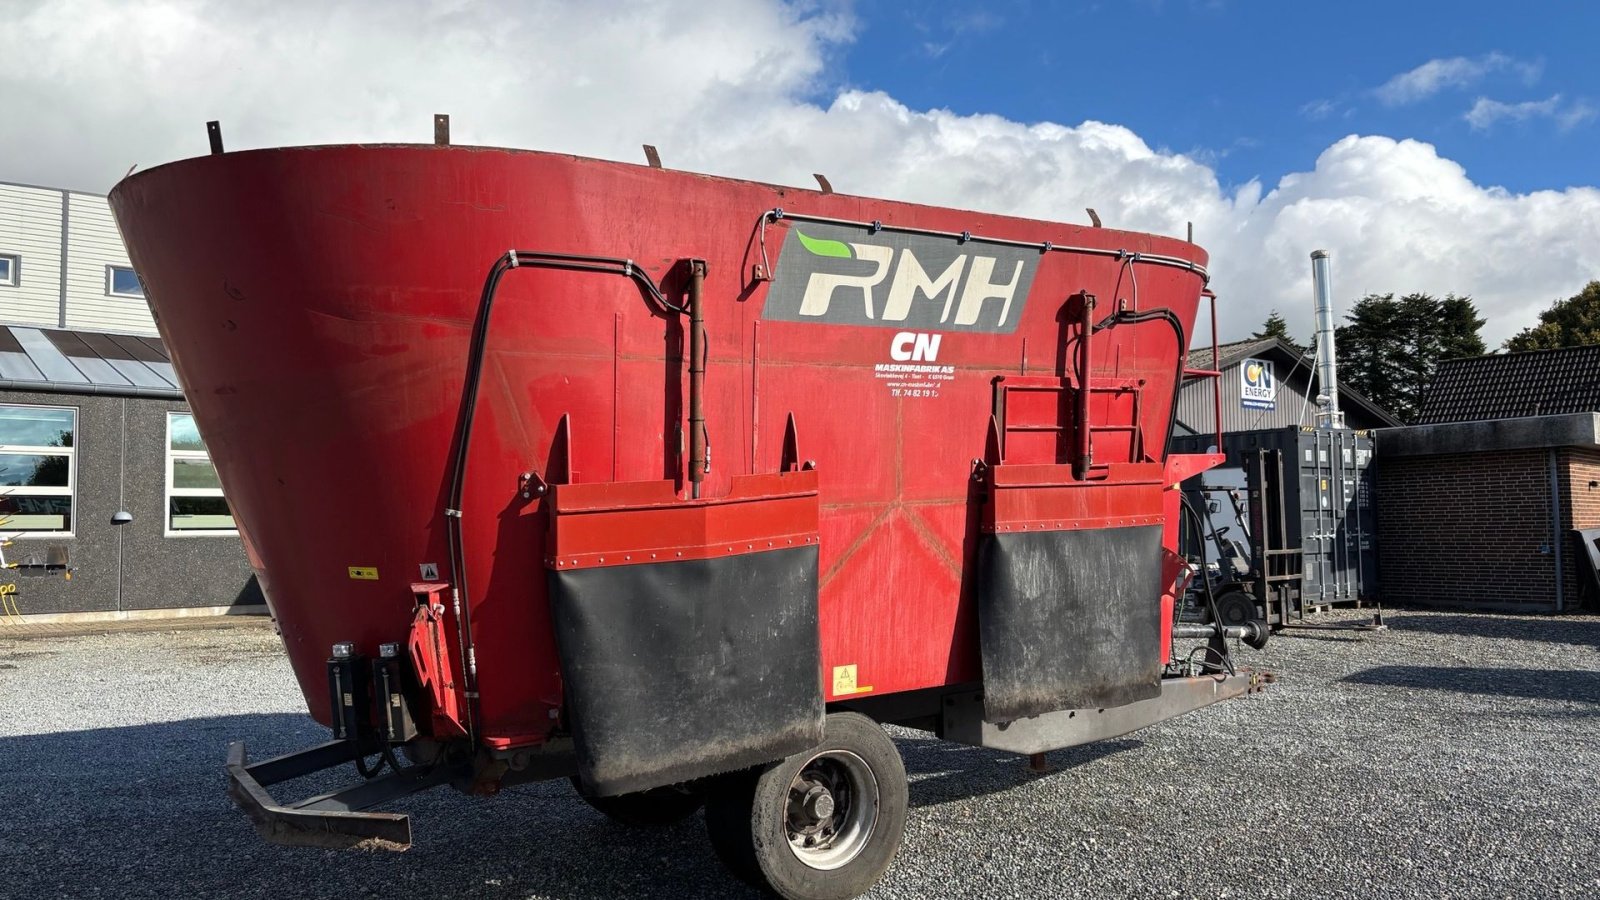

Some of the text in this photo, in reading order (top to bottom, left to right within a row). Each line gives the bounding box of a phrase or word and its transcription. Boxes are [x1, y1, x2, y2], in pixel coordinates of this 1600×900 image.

[797, 231, 1024, 327] RMH
[890, 332, 942, 361] CN
[875, 364, 940, 373] MASKINFABRIK
[1244, 360, 1271, 388] CN
[1245, 387, 1271, 397] ENERGY
